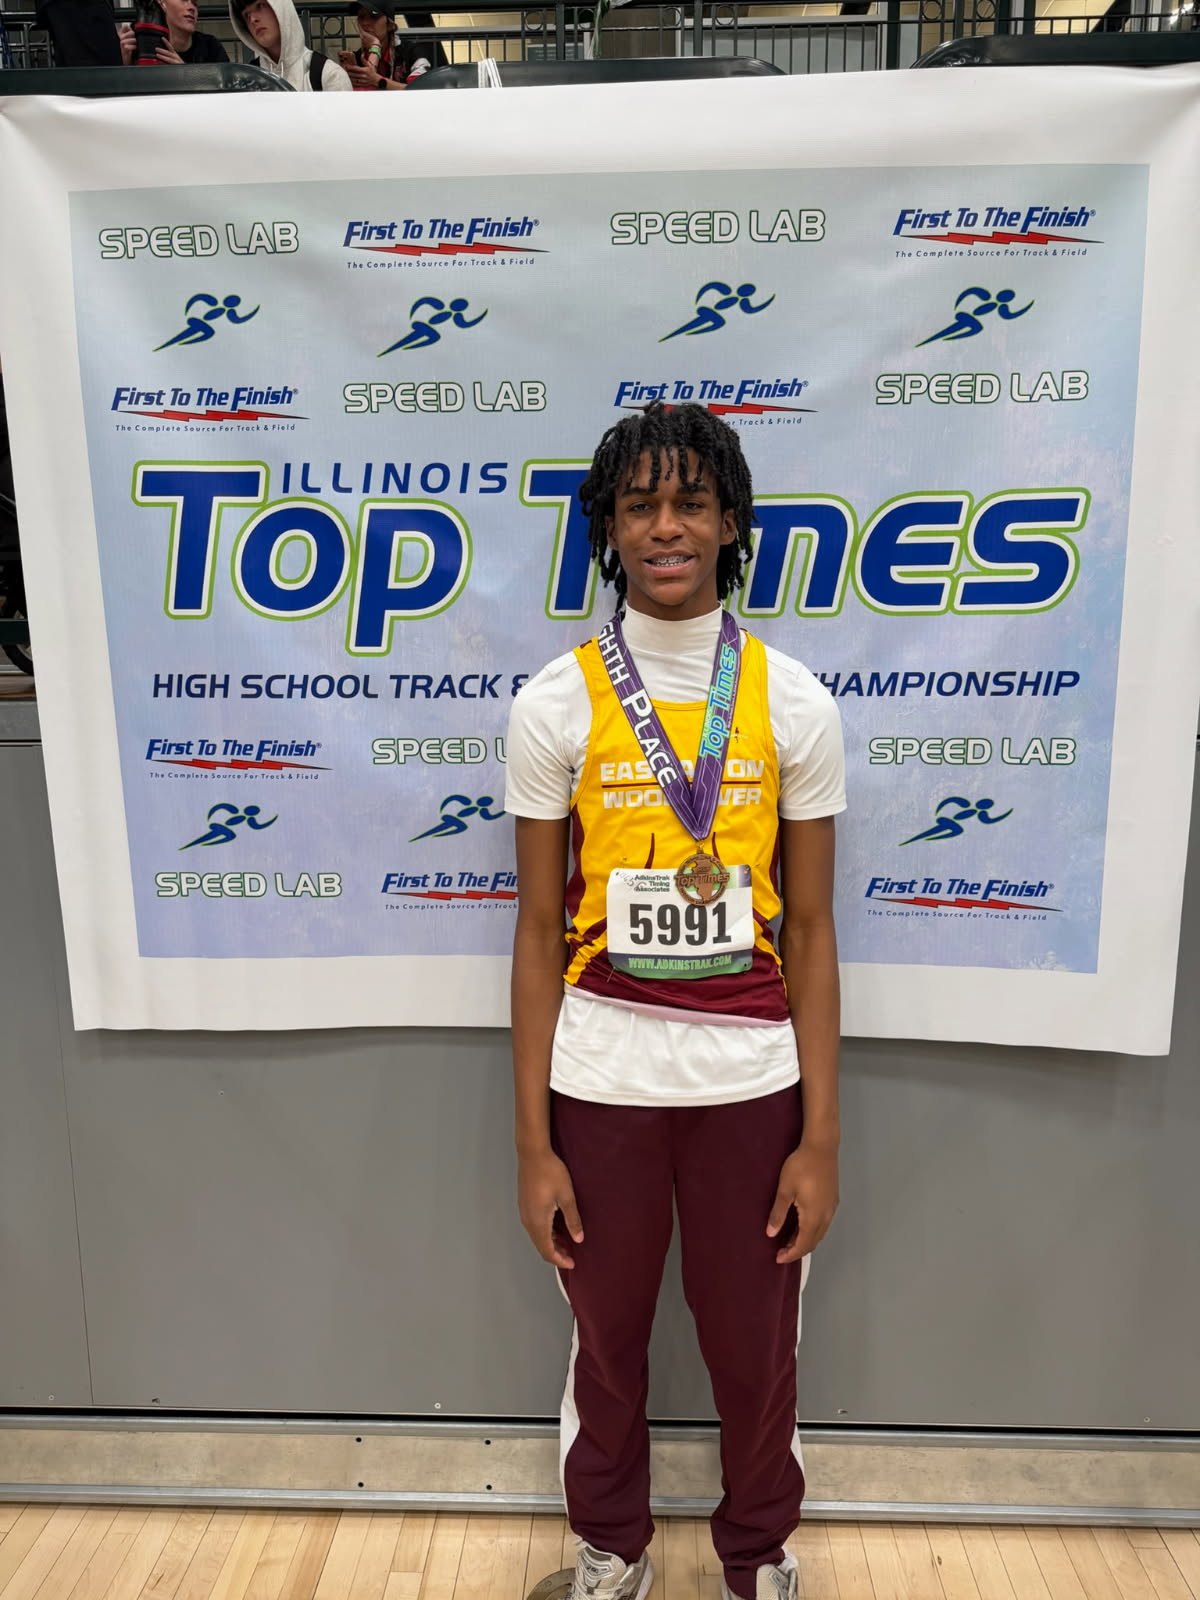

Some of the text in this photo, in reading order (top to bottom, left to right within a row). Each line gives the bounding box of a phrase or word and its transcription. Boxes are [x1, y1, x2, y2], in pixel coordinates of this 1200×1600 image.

[343, 221, 398, 246] First
[402, 219, 424, 239] To
[428, 218, 465, 239] The
[610, 209, 827, 246] SPEED LAB
[893, 209, 952, 235] First
[956, 207, 978, 228] To
[984, 206, 1020, 227] The
[98, 220, 300, 260] SPEED LAB
[916, 250, 964, 259] Complete
[967, 249, 1000, 257] Source
[1061, 248, 1087, 256] Field
[367, 261, 413, 270] Complete
[416, 260, 449, 268] Source
[111, 387, 166, 411] First
[170, 388, 191, 406] To
[196, 387, 229, 406] The
[343, 380, 547, 414] SPEED LAB
[614, 382, 669, 407] First
[672, 380, 694, 400] To
[699, 379, 735, 400] The
[875, 370, 1089, 405] SPEED LAB
[115, 424, 132, 432] The
[135, 424, 181, 433] Complete
[184, 424, 216, 432] Source
[219, 424, 234, 432] For
[272, 423, 296, 431] Field
[739, 418, 764, 426] Track
[777, 417, 802, 425] Field
[281, 462, 509, 494] ILLINOIS
[132, 460, 473, 656] Top
[153, 673, 231, 699] HIGH
[240, 673, 379, 699] SCHOOL
[390, 673, 503, 699] TRACK
[813, 670, 1081, 697] HAMPIONSHIP
[146, 738, 194, 760] First
[198, 739, 217, 756] To
[223, 739, 254, 757] The
[372, 737, 488, 765] SPEED
[869, 736, 1077, 766] SPEED LAB
[168, 772, 209, 780] Complete
[211, 772, 241, 780] Source
[155, 871, 342, 898] SPEED LAB
[381, 872, 430, 893] First
[433, 872, 454, 888] To
[457, 872, 489, 888] The
[864, 877, 918, 899] First
[921, 878, 943, 895] To
[946, 878, 982, 896] The
[629, 902, 732, 946] 5991
[886, 910, 929, 918] Complete
[932, 911, 964, 919] Source
[967, 911, 982, 919] For
[985, 912, 1011, 920] Track
[628, 954, 732, 970] WWW.ADKINSTRAK.COM
